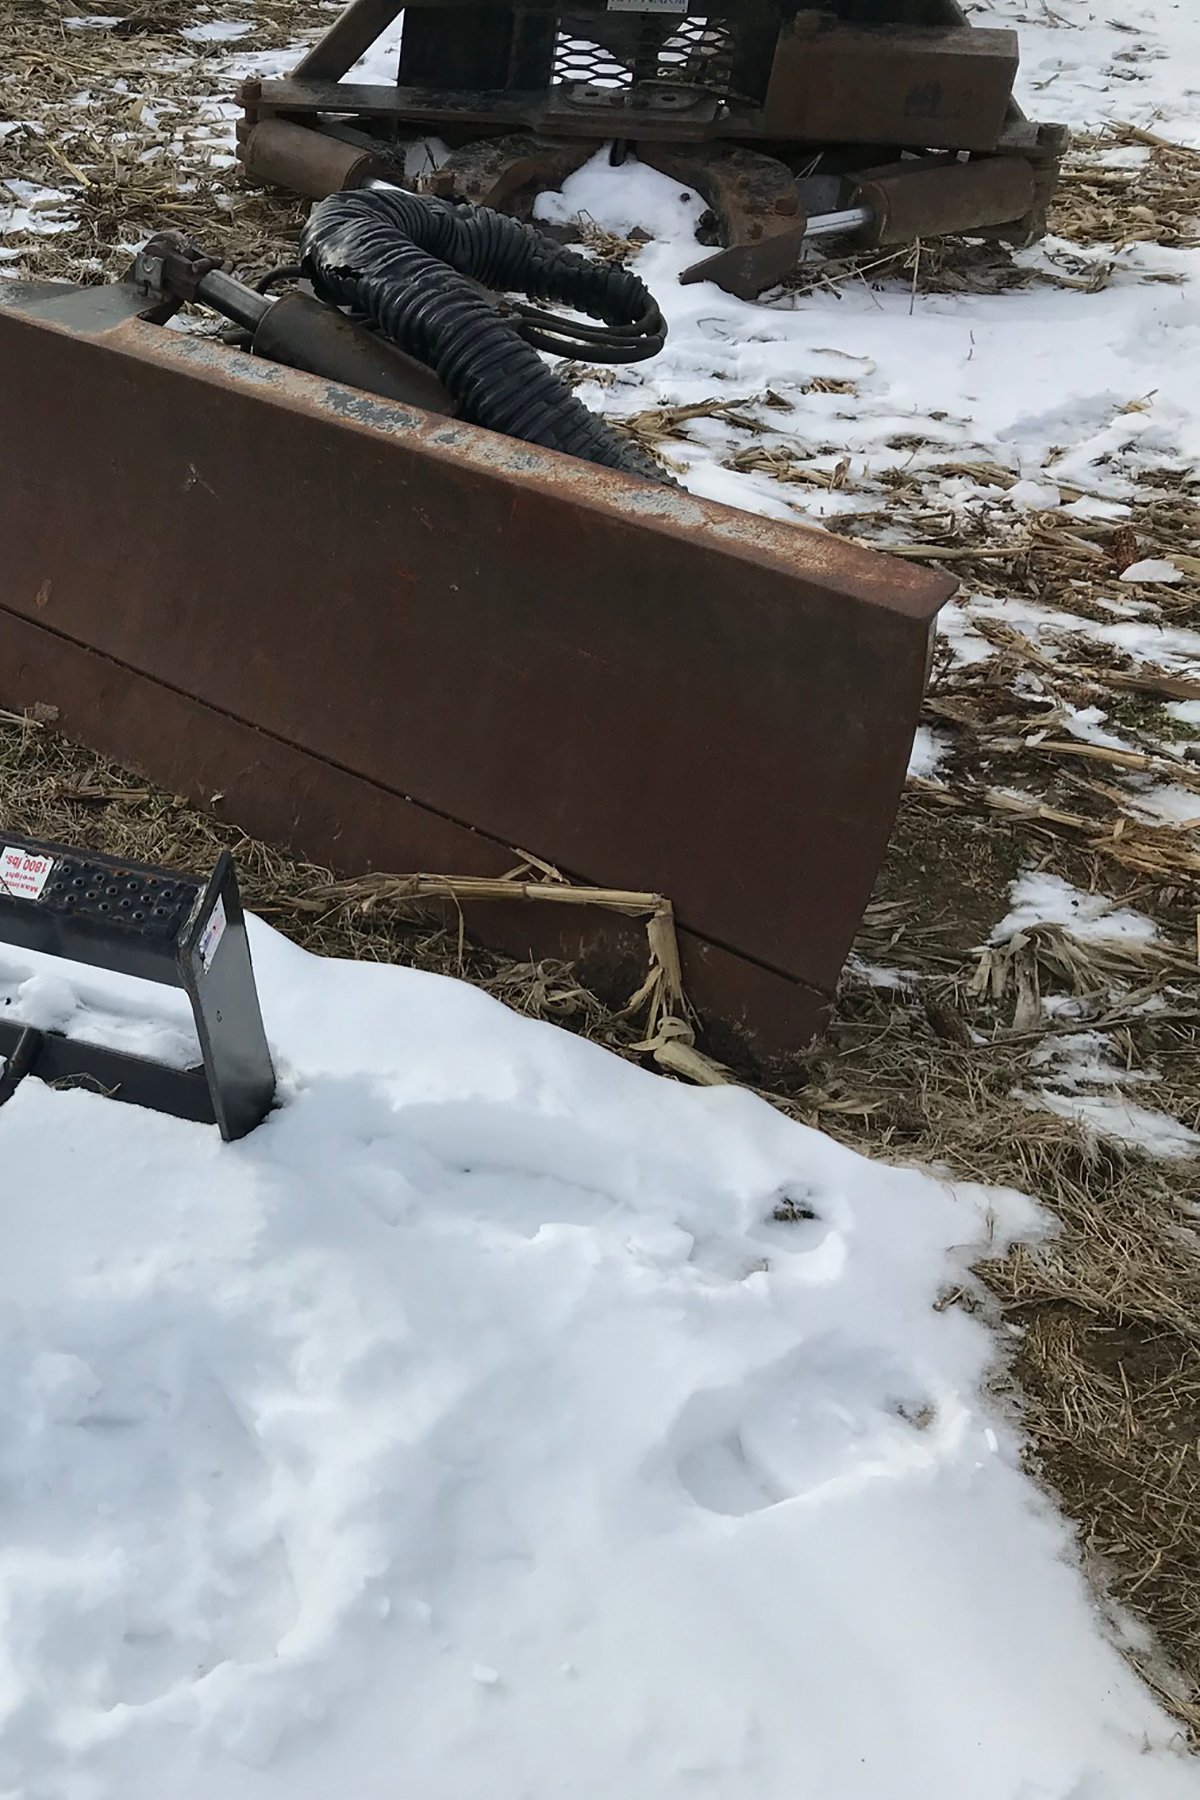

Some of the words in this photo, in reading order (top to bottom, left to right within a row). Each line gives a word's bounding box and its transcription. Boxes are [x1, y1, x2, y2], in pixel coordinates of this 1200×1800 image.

[5, 854, 22, 869] lbs.
[22, 858, 48, 874] 1800
[5, 871, 35, 882] weight
